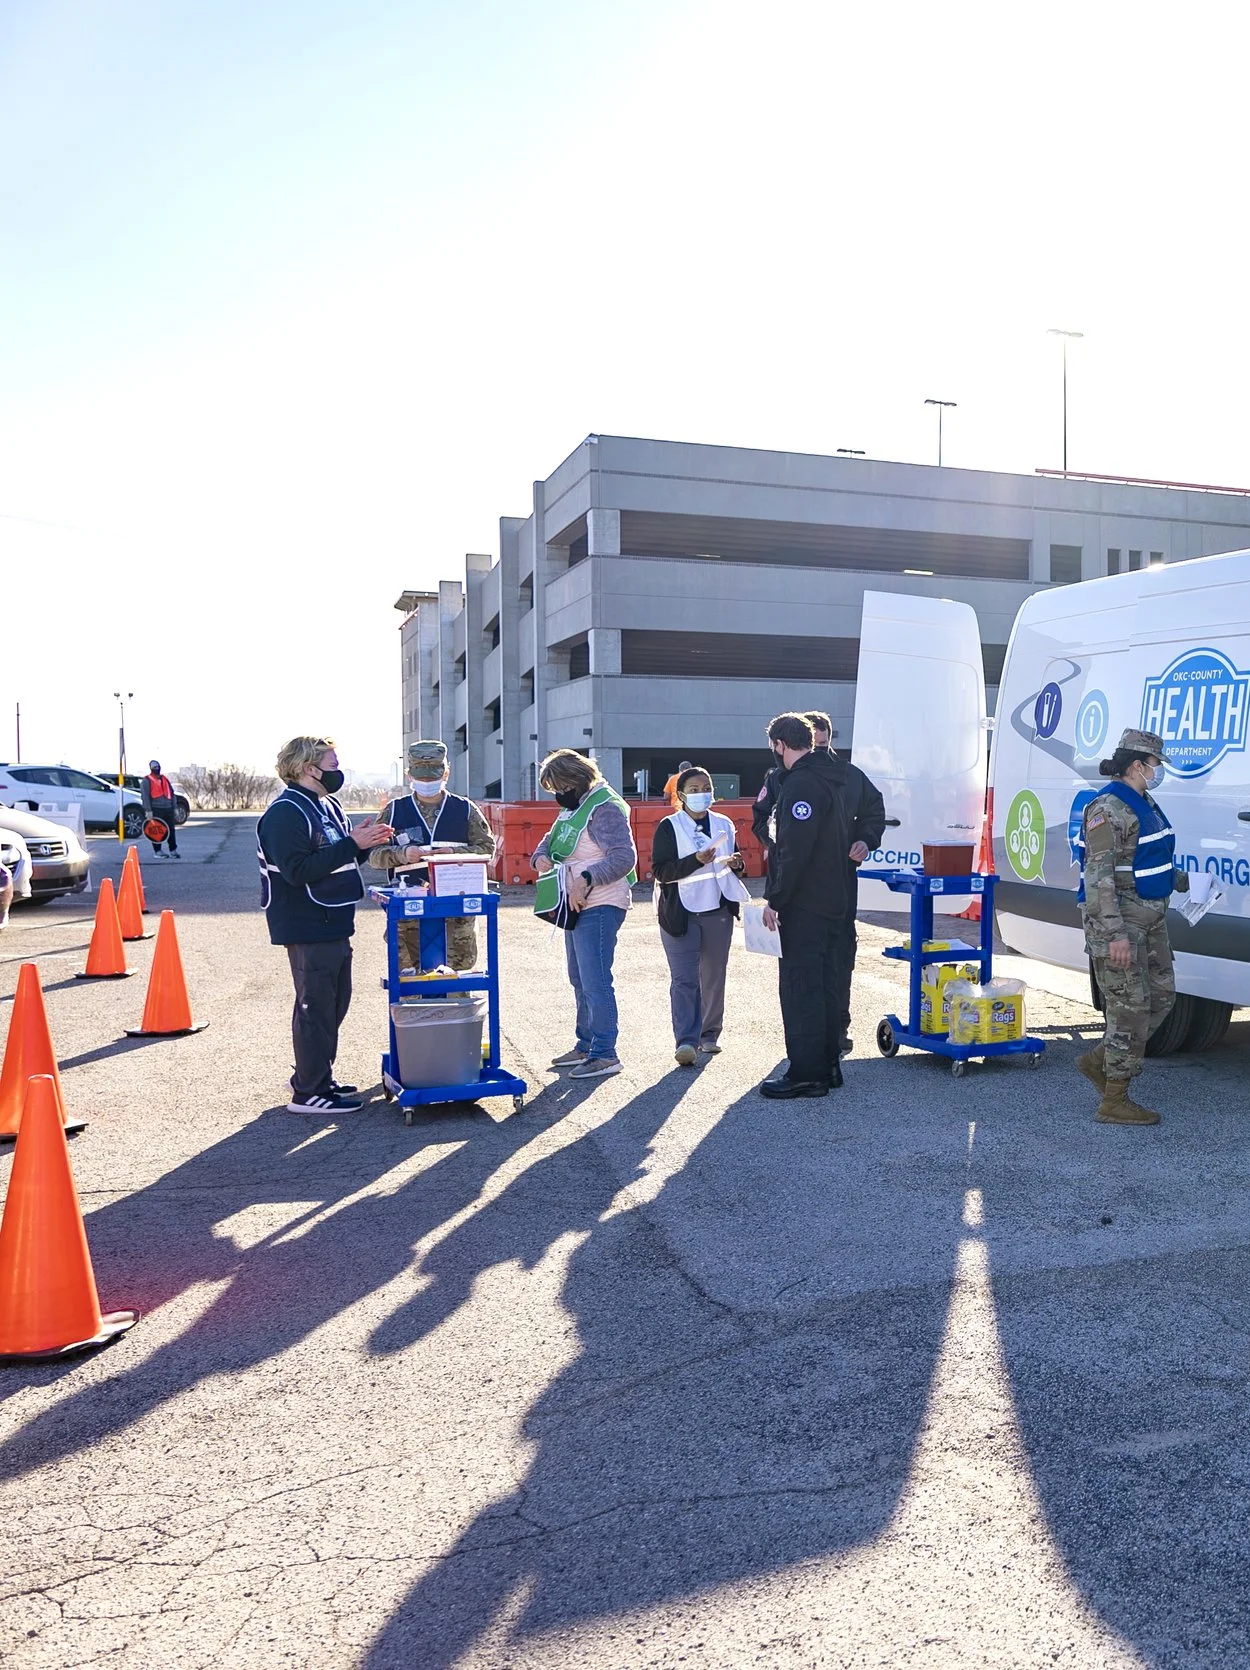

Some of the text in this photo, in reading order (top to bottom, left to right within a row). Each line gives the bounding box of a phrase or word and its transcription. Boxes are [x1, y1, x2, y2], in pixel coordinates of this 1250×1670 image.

[1146, 683, 1245, 740] HEALTH
[1166, 747, 1212, 756] DEPARTMENT
[992, 1011, 1015, 1024] Rags
